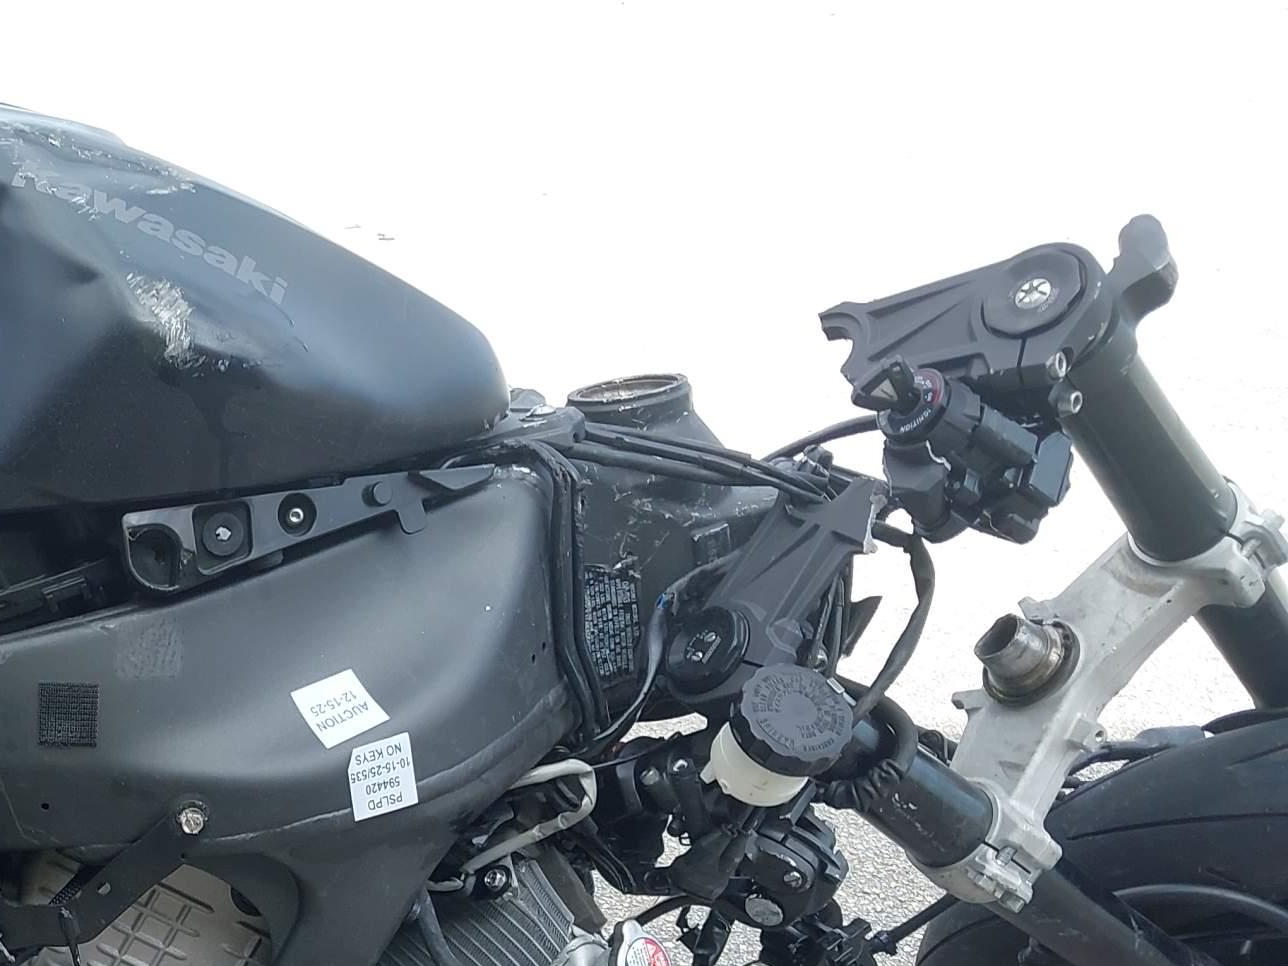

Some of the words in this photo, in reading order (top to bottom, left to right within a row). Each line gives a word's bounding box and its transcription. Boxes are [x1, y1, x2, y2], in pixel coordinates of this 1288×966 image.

[310, 690, 357, 717] 12-15-25
[316, 701, 369, 732] AUCTION
[355, 748, 383, 765] KEYS
[386, 743, 402, 756] NO
[366, 776, 400, 795] 594420
[368, 792, 403, 811] PSLPD
